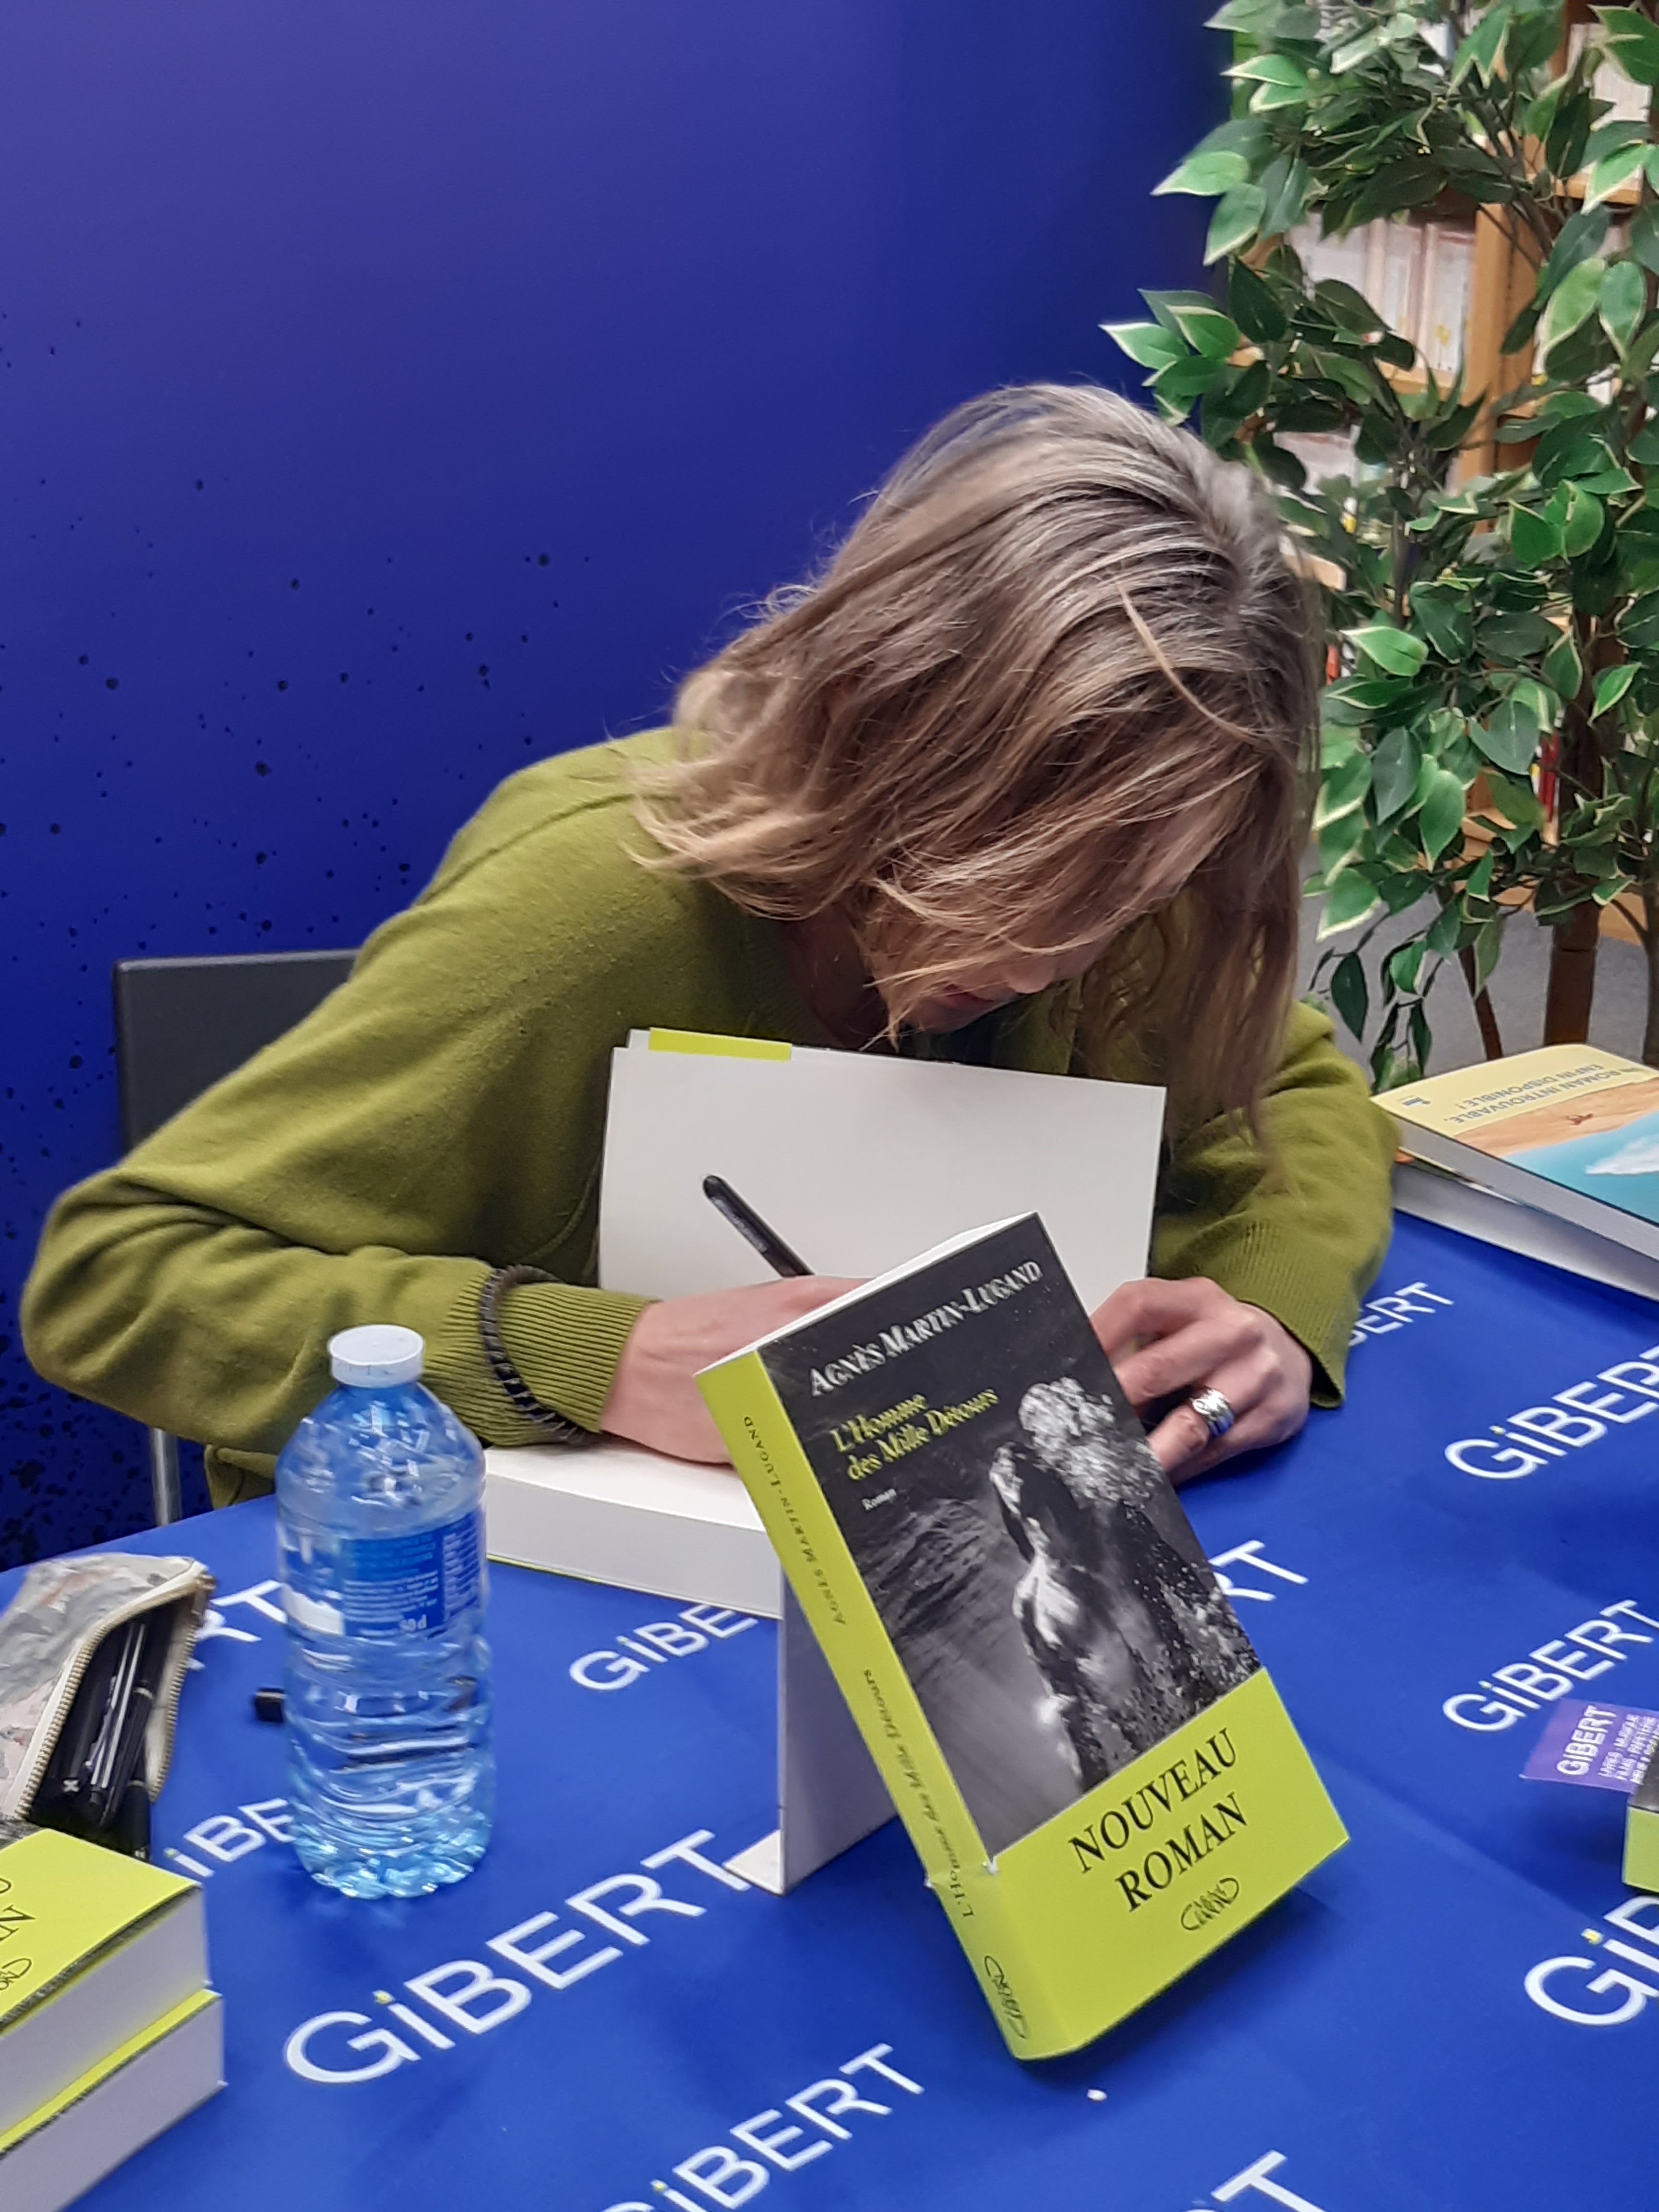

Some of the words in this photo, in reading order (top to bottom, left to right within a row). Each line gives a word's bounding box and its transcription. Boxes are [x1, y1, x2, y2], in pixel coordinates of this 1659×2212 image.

[1462, 1075, 1554, 1107] DISPONIBLE
[1555, 1063, 1605, 1081] ENFIN
[1559, 1070, 1622, 1091] ROMAN
[1444, 1345, 1659, 1479] GiBER
[847, 1454, 883, 1480] des
[875, 1423, 930, 1463] Mille
[861, 1489, 897, 1511] Roman
[1556, 1705, 1617, 1775] GIBERT
[1068, 1728, 1237, 1874] NOUVEAU
[1114, 1791, 1248, 1912] ROMAN
